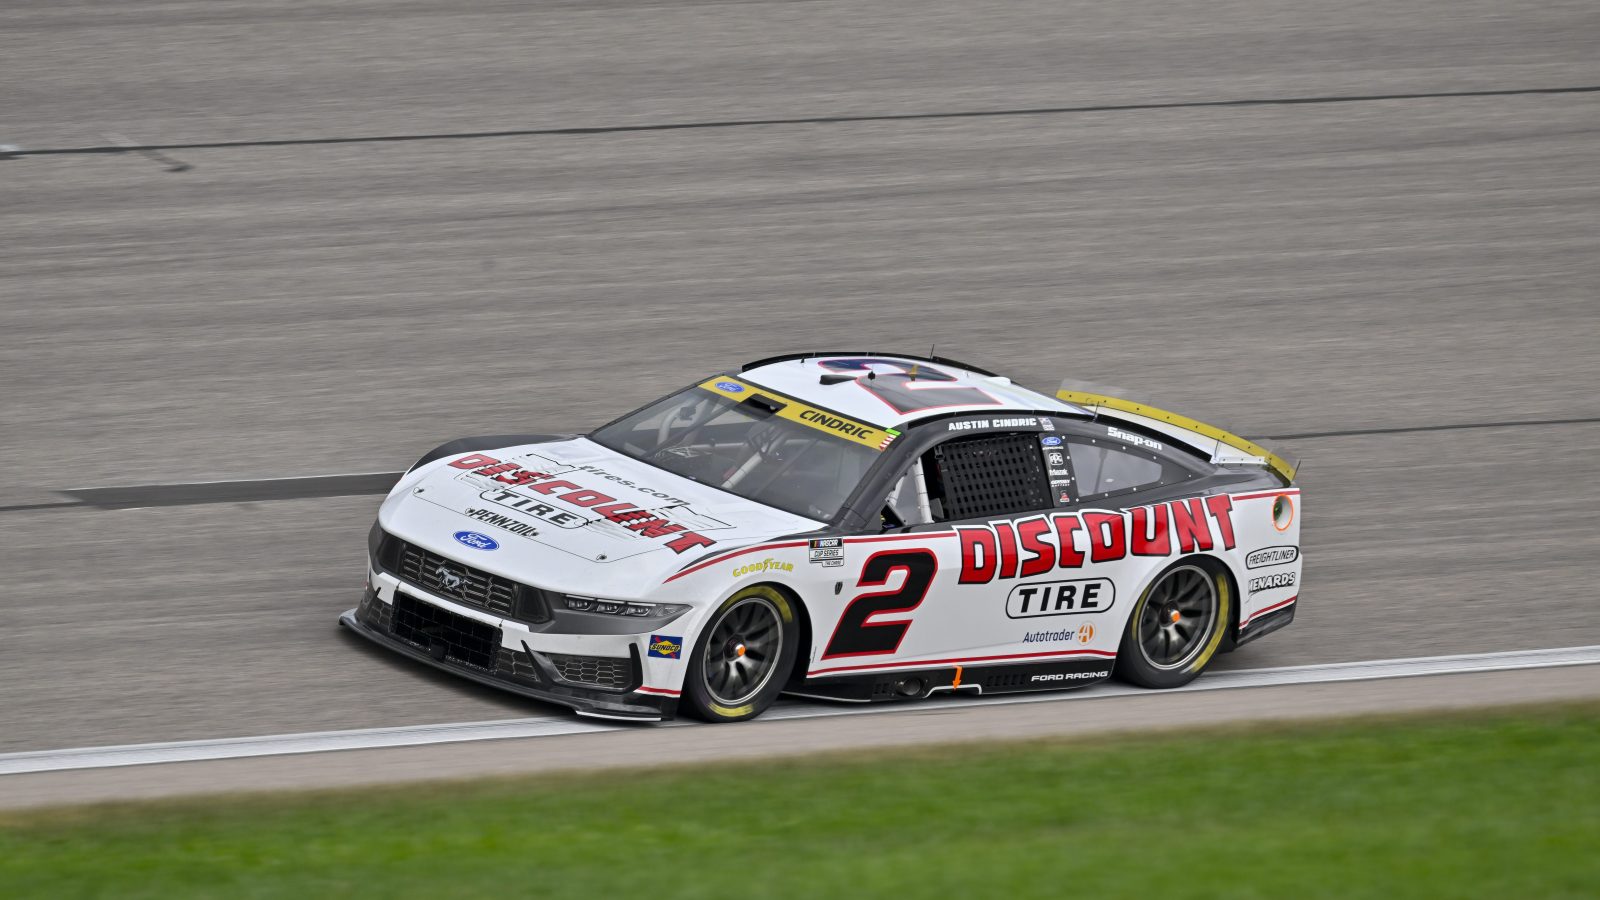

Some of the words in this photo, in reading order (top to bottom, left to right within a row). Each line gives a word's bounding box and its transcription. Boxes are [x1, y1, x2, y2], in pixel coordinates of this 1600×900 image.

[800, 410, 873, 439] CINDRIC
[948, 420, 989, 431] AUSTIN
[992, 417, 1037, 428] CINDRIC
[1107, 426, 1162, 450] Snap-on
[578, 464, 691, 506] tires.com
[448, 453, 717, 554] DISCOUNT
[494, 491, 578, 525] TIRE
[474, 509, 534, 537] PENNZOIL
[957, 494, 1236, 584] DISCOUNT
[732, 557, 794, 577] GOODYEAR
[1249, 549, 1295, 565] FREIGHTLINER
[821, 548, 939, 660] 2
[1018, 584, 1101, 613] TIRE
[651, 643, 680, 652] SUNOCO
[1022, 629, 1075, 643] Autotrader
[1065, 671, 1109, 679] RACING
